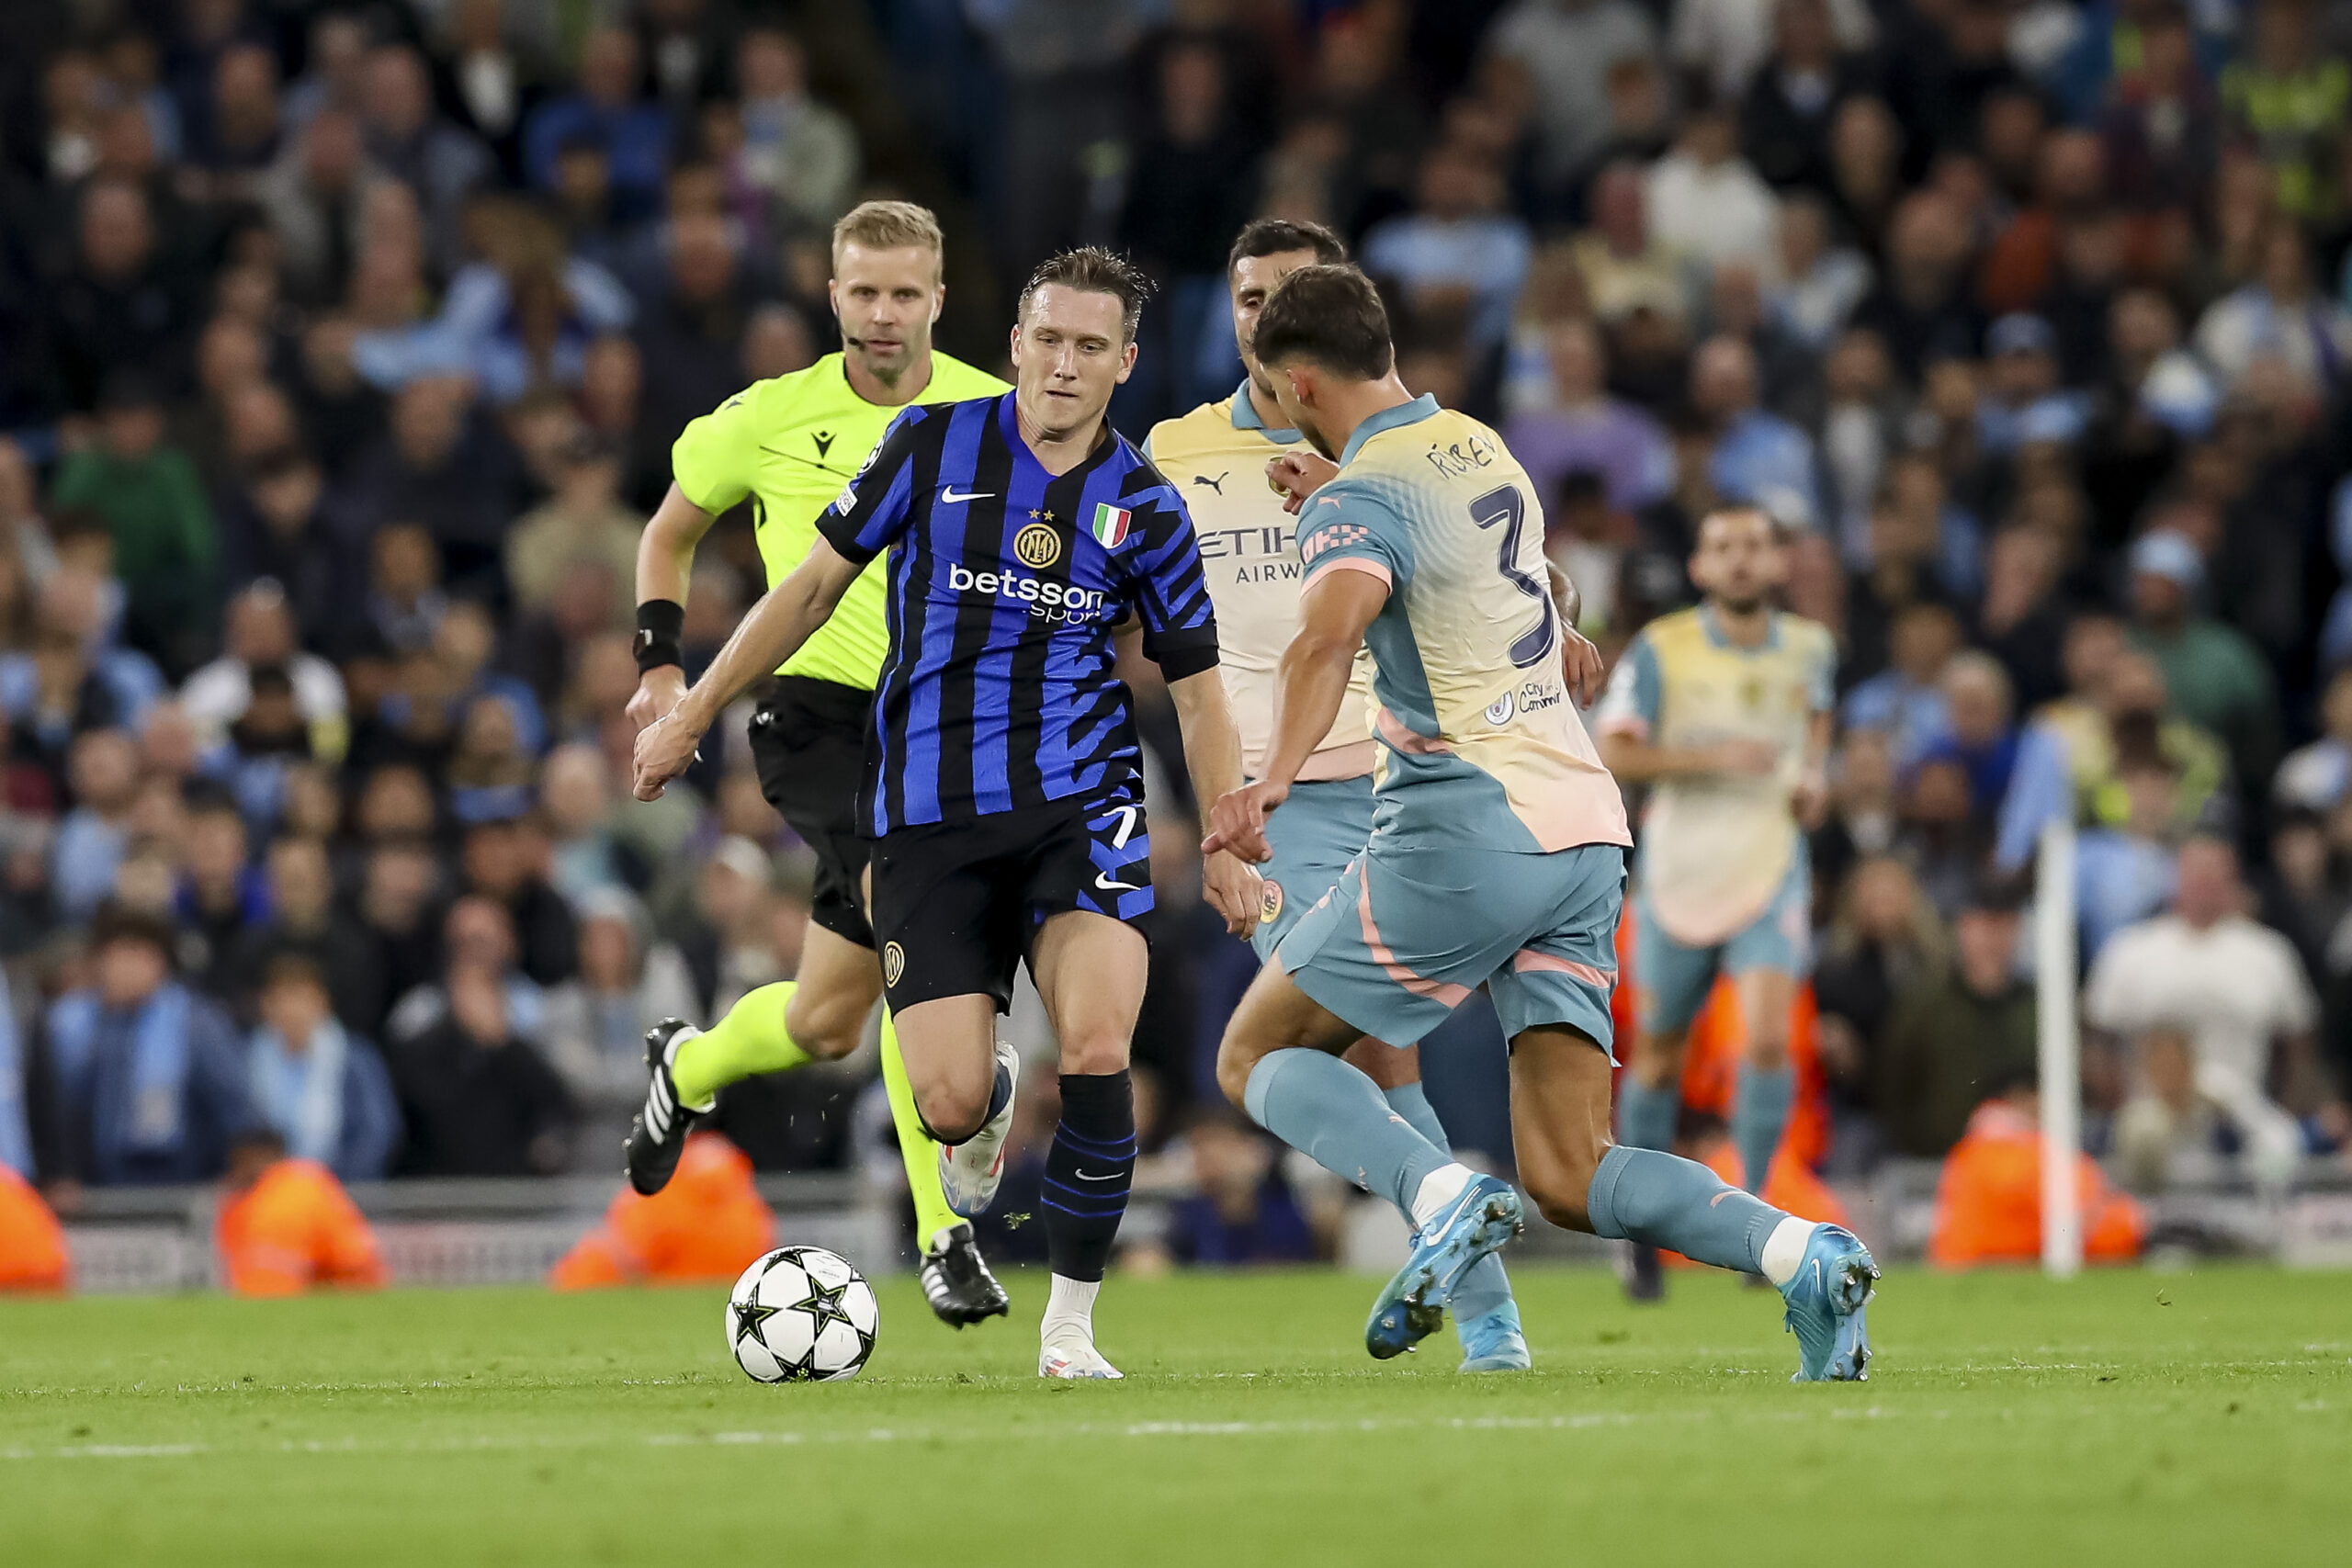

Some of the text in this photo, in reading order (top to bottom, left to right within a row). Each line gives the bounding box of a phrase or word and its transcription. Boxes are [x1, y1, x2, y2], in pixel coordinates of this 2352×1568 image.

[948, 562, 1104, 610] betsson
[1468, 483, 1555, 669] 3
[1102, 806, 1137, 851] 7
